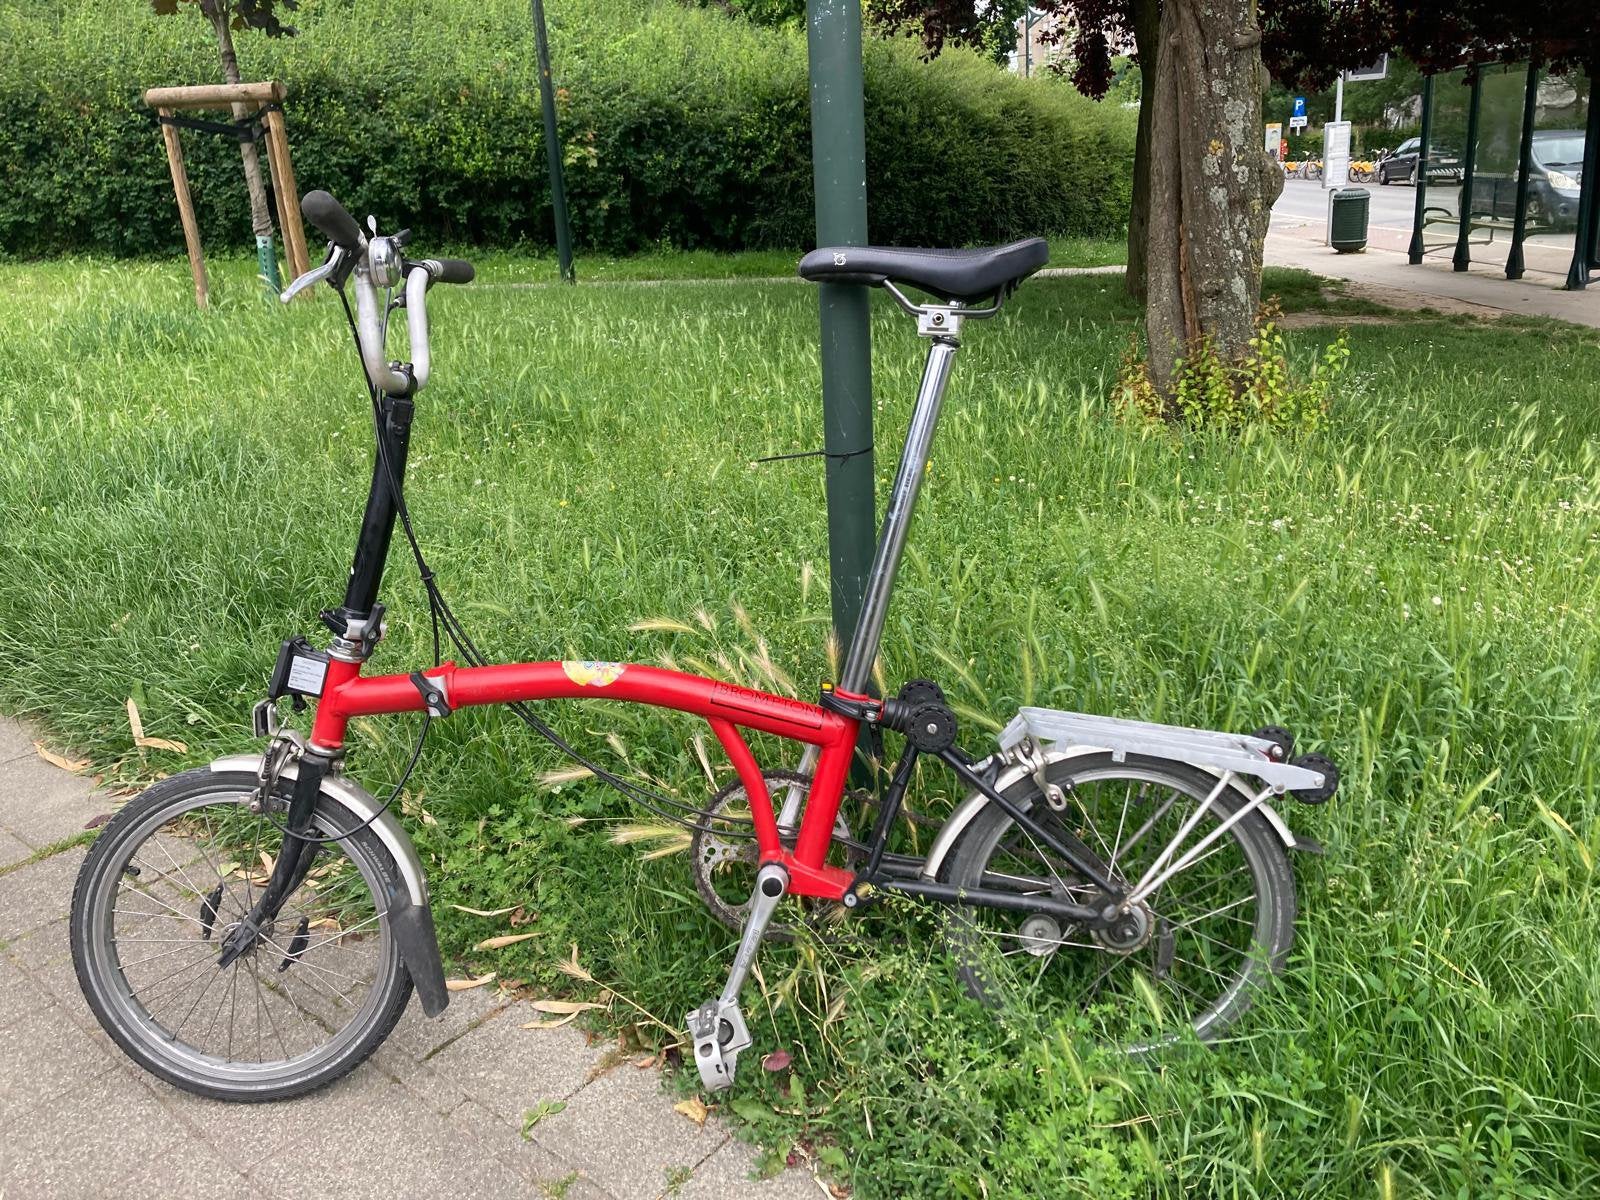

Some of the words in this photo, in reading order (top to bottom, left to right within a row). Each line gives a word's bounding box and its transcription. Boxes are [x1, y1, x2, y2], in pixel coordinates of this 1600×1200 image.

[1296, 99, 1304, 111] P
[719, 682, 818, 717] BROMPTON
[361, 841, 391, 883] SCHWALBE
